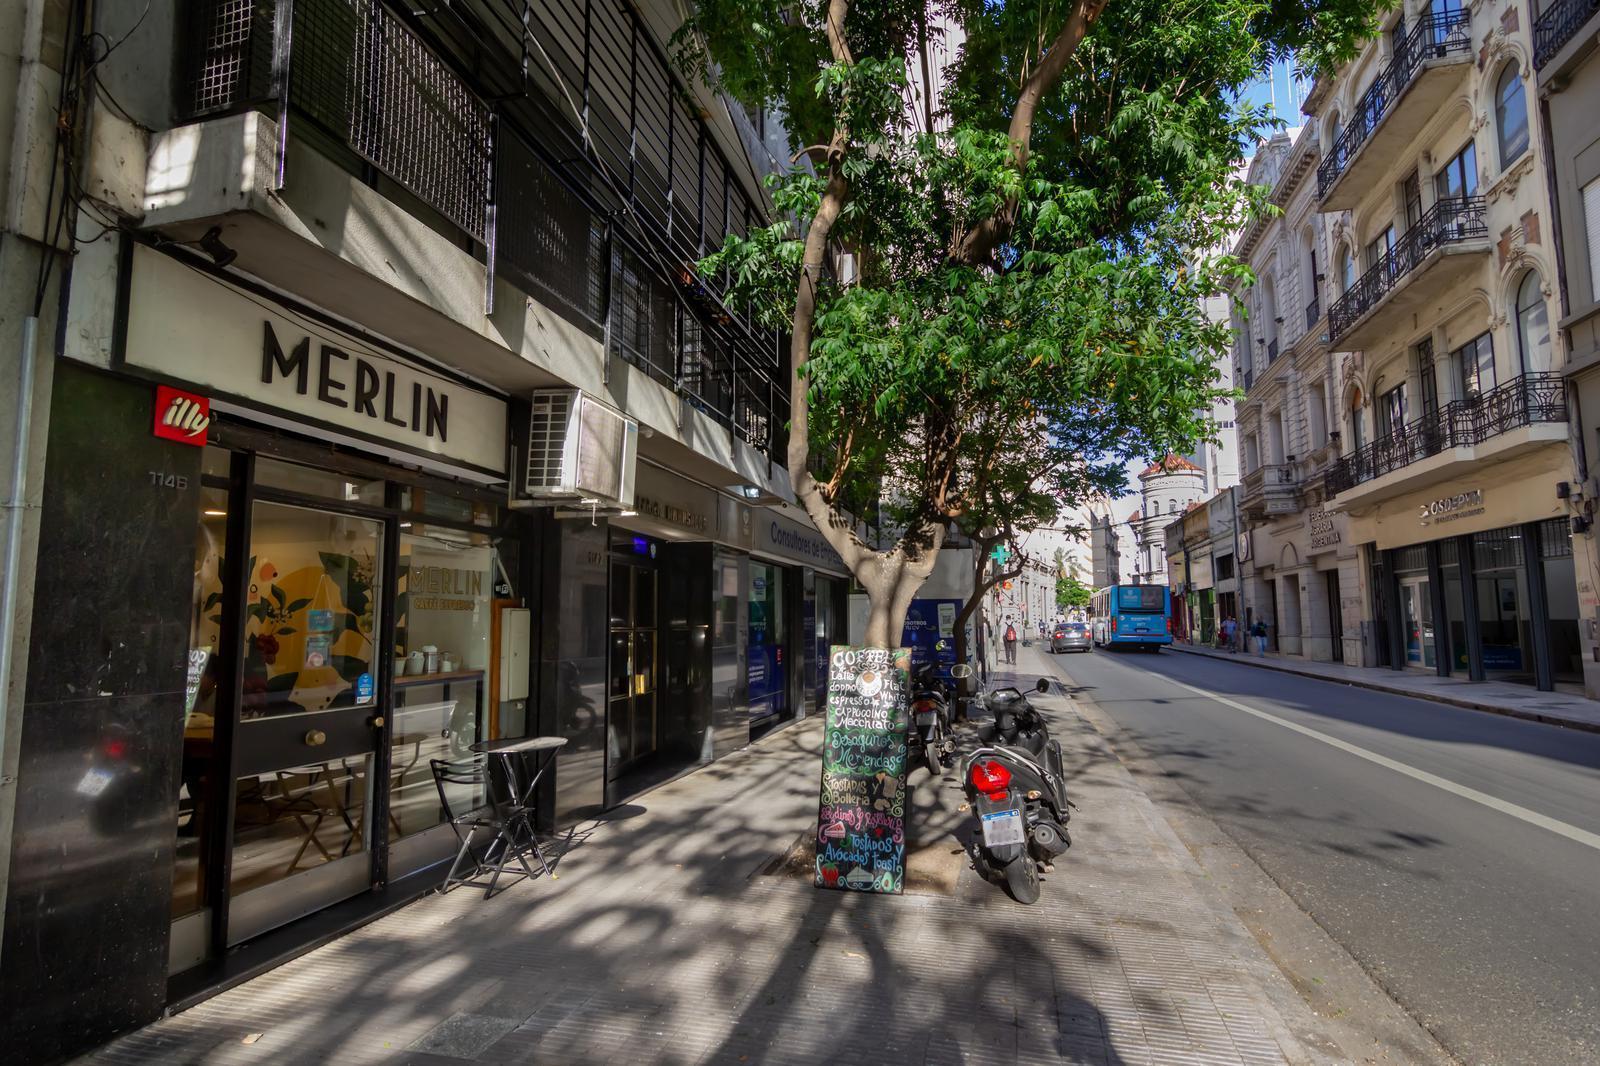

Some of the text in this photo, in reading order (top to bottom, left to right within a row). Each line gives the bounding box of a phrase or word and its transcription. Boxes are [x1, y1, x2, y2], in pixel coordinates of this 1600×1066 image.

[261, 319, 449, 443] MERLIN
[162, 396, 211, 438] illy
[770, 521, 810, 555] Consultores
[812, 538, 820, 558] de
[409, 566, 482, 596] MERLIN
[884, 679, 905, 691] Flat
[830, 695, 870, 709] espresso
[879, 691, 906, 702] White
[834, 716, 895, 730] Macchiato
